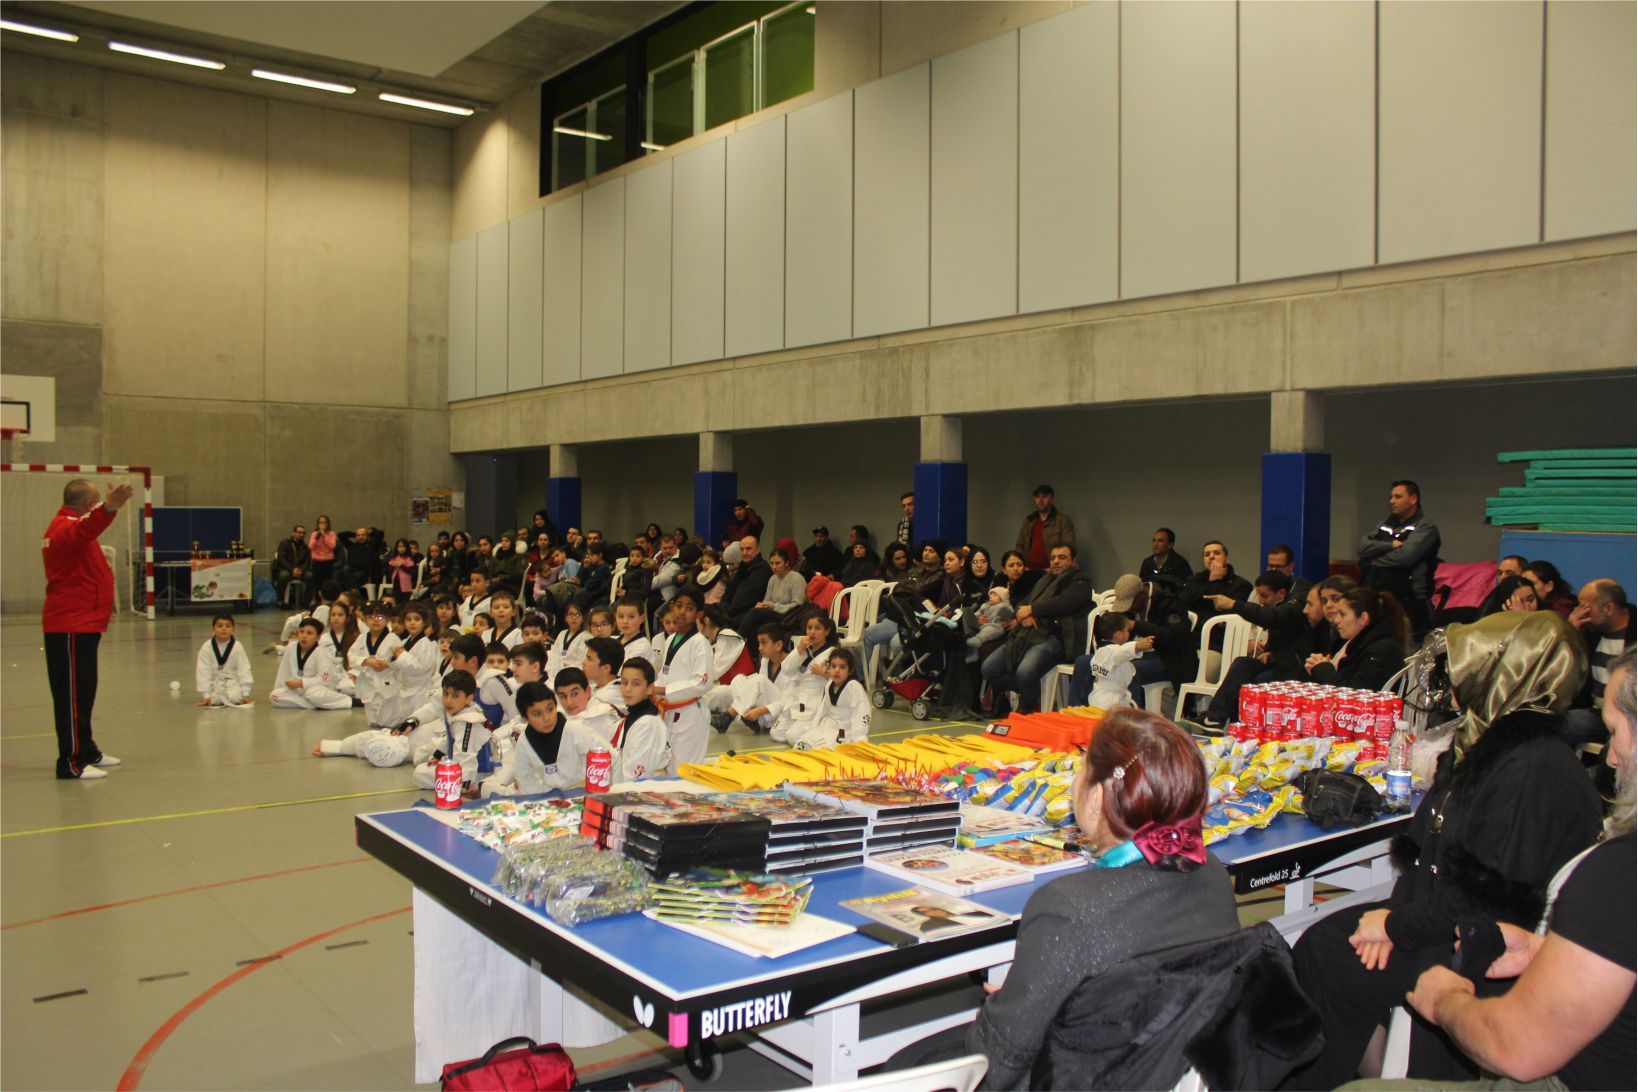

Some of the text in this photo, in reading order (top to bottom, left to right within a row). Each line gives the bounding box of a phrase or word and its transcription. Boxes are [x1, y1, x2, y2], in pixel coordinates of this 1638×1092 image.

[1250, 868, 1289, 888] Centrefold 25
[701, 990, 792, 1040] BUTTERFLY
